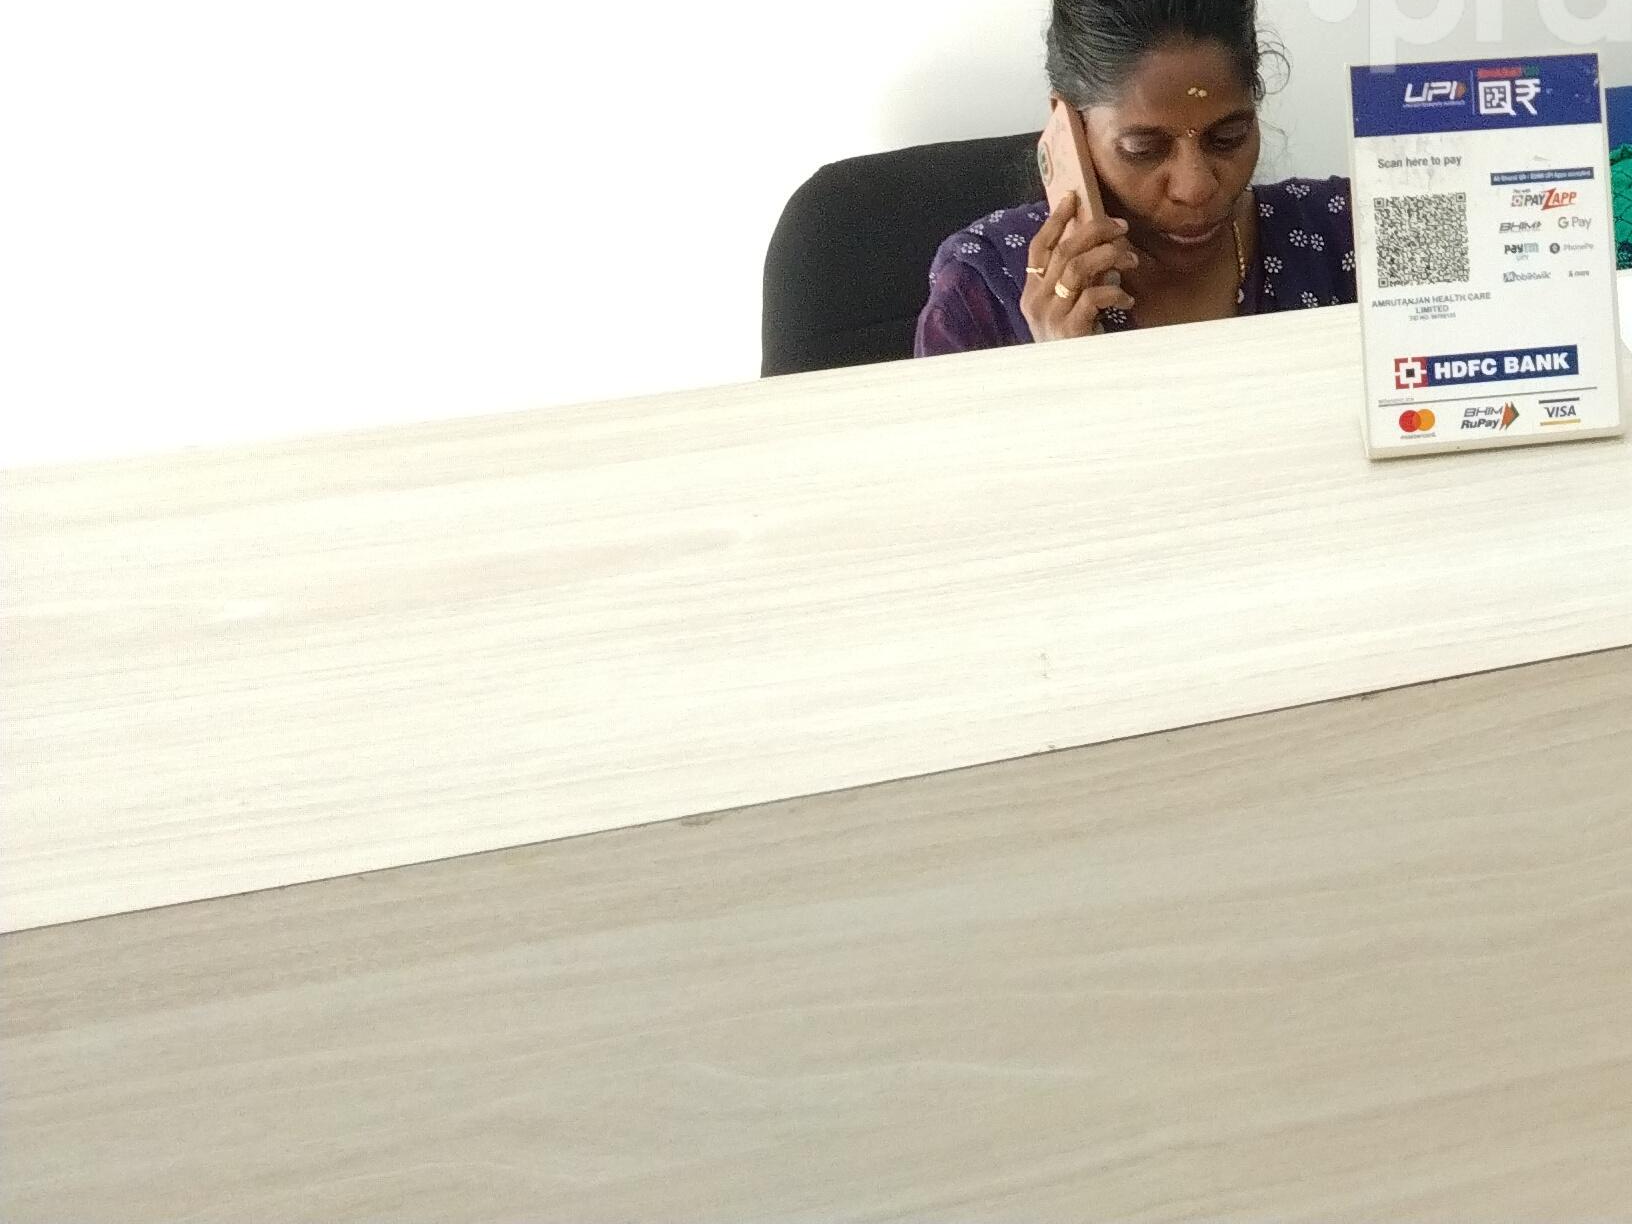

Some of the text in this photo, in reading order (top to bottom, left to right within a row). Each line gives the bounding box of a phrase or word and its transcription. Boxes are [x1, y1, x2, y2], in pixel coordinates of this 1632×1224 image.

[1404, 80, 1457, 103] UPI
[1377, 155, 1462, 168] Scan here to pay
[1571, 216, 1592, 229] Pay
[1372, 292, 1491, 307] AMRUTANJAN HEALTH CARE
[1416, 304, 1449, 314] LIMITED
[1435, 352, 1569, 380] HDFC BANK
[1464, 406, 1503, 418] BHIM
[1544, 405, 1577, 418] VISA
[1461, 418, 1500, 430] RuPay
